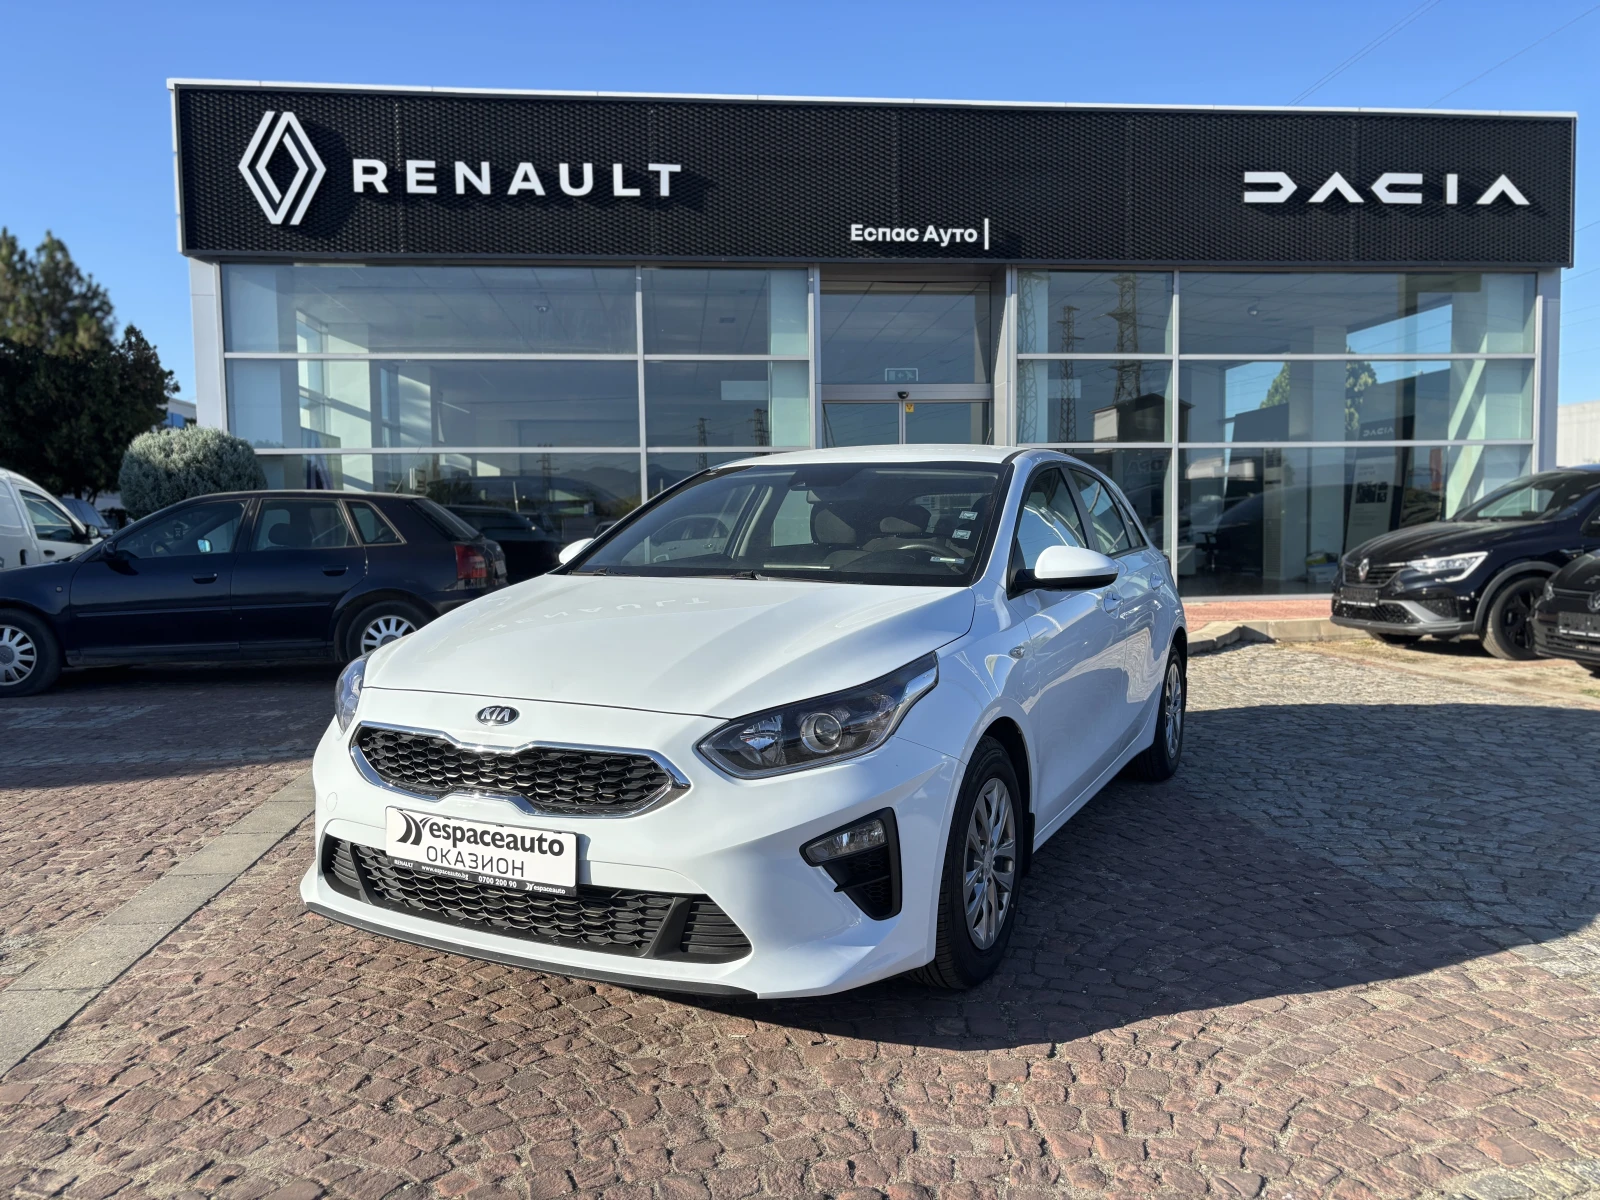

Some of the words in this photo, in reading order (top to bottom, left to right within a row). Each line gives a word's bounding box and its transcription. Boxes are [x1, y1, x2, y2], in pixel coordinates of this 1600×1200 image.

[352, 158, 682, 197] RENAULT
[1244, 171, 1531, 205] DACIA
[850, 224, 919, 242] Еспас
[922, 225, 978, 247] Ауто
[1362, 426, 1394, 437] DACIA
[480, 707, 511, 722] KIA
[428, 821, 565, 857] espaceauto
[426, 845, 524, 878] ОКАЗИОН
[421, 865, 469, 880] www.espaceauto.bg
[478, 875, 494, 885] 0700
[495, 878, 508, 887] 200
[508, 880, 517, 888] 90
[533, 886, 566, 895] espaceauto
